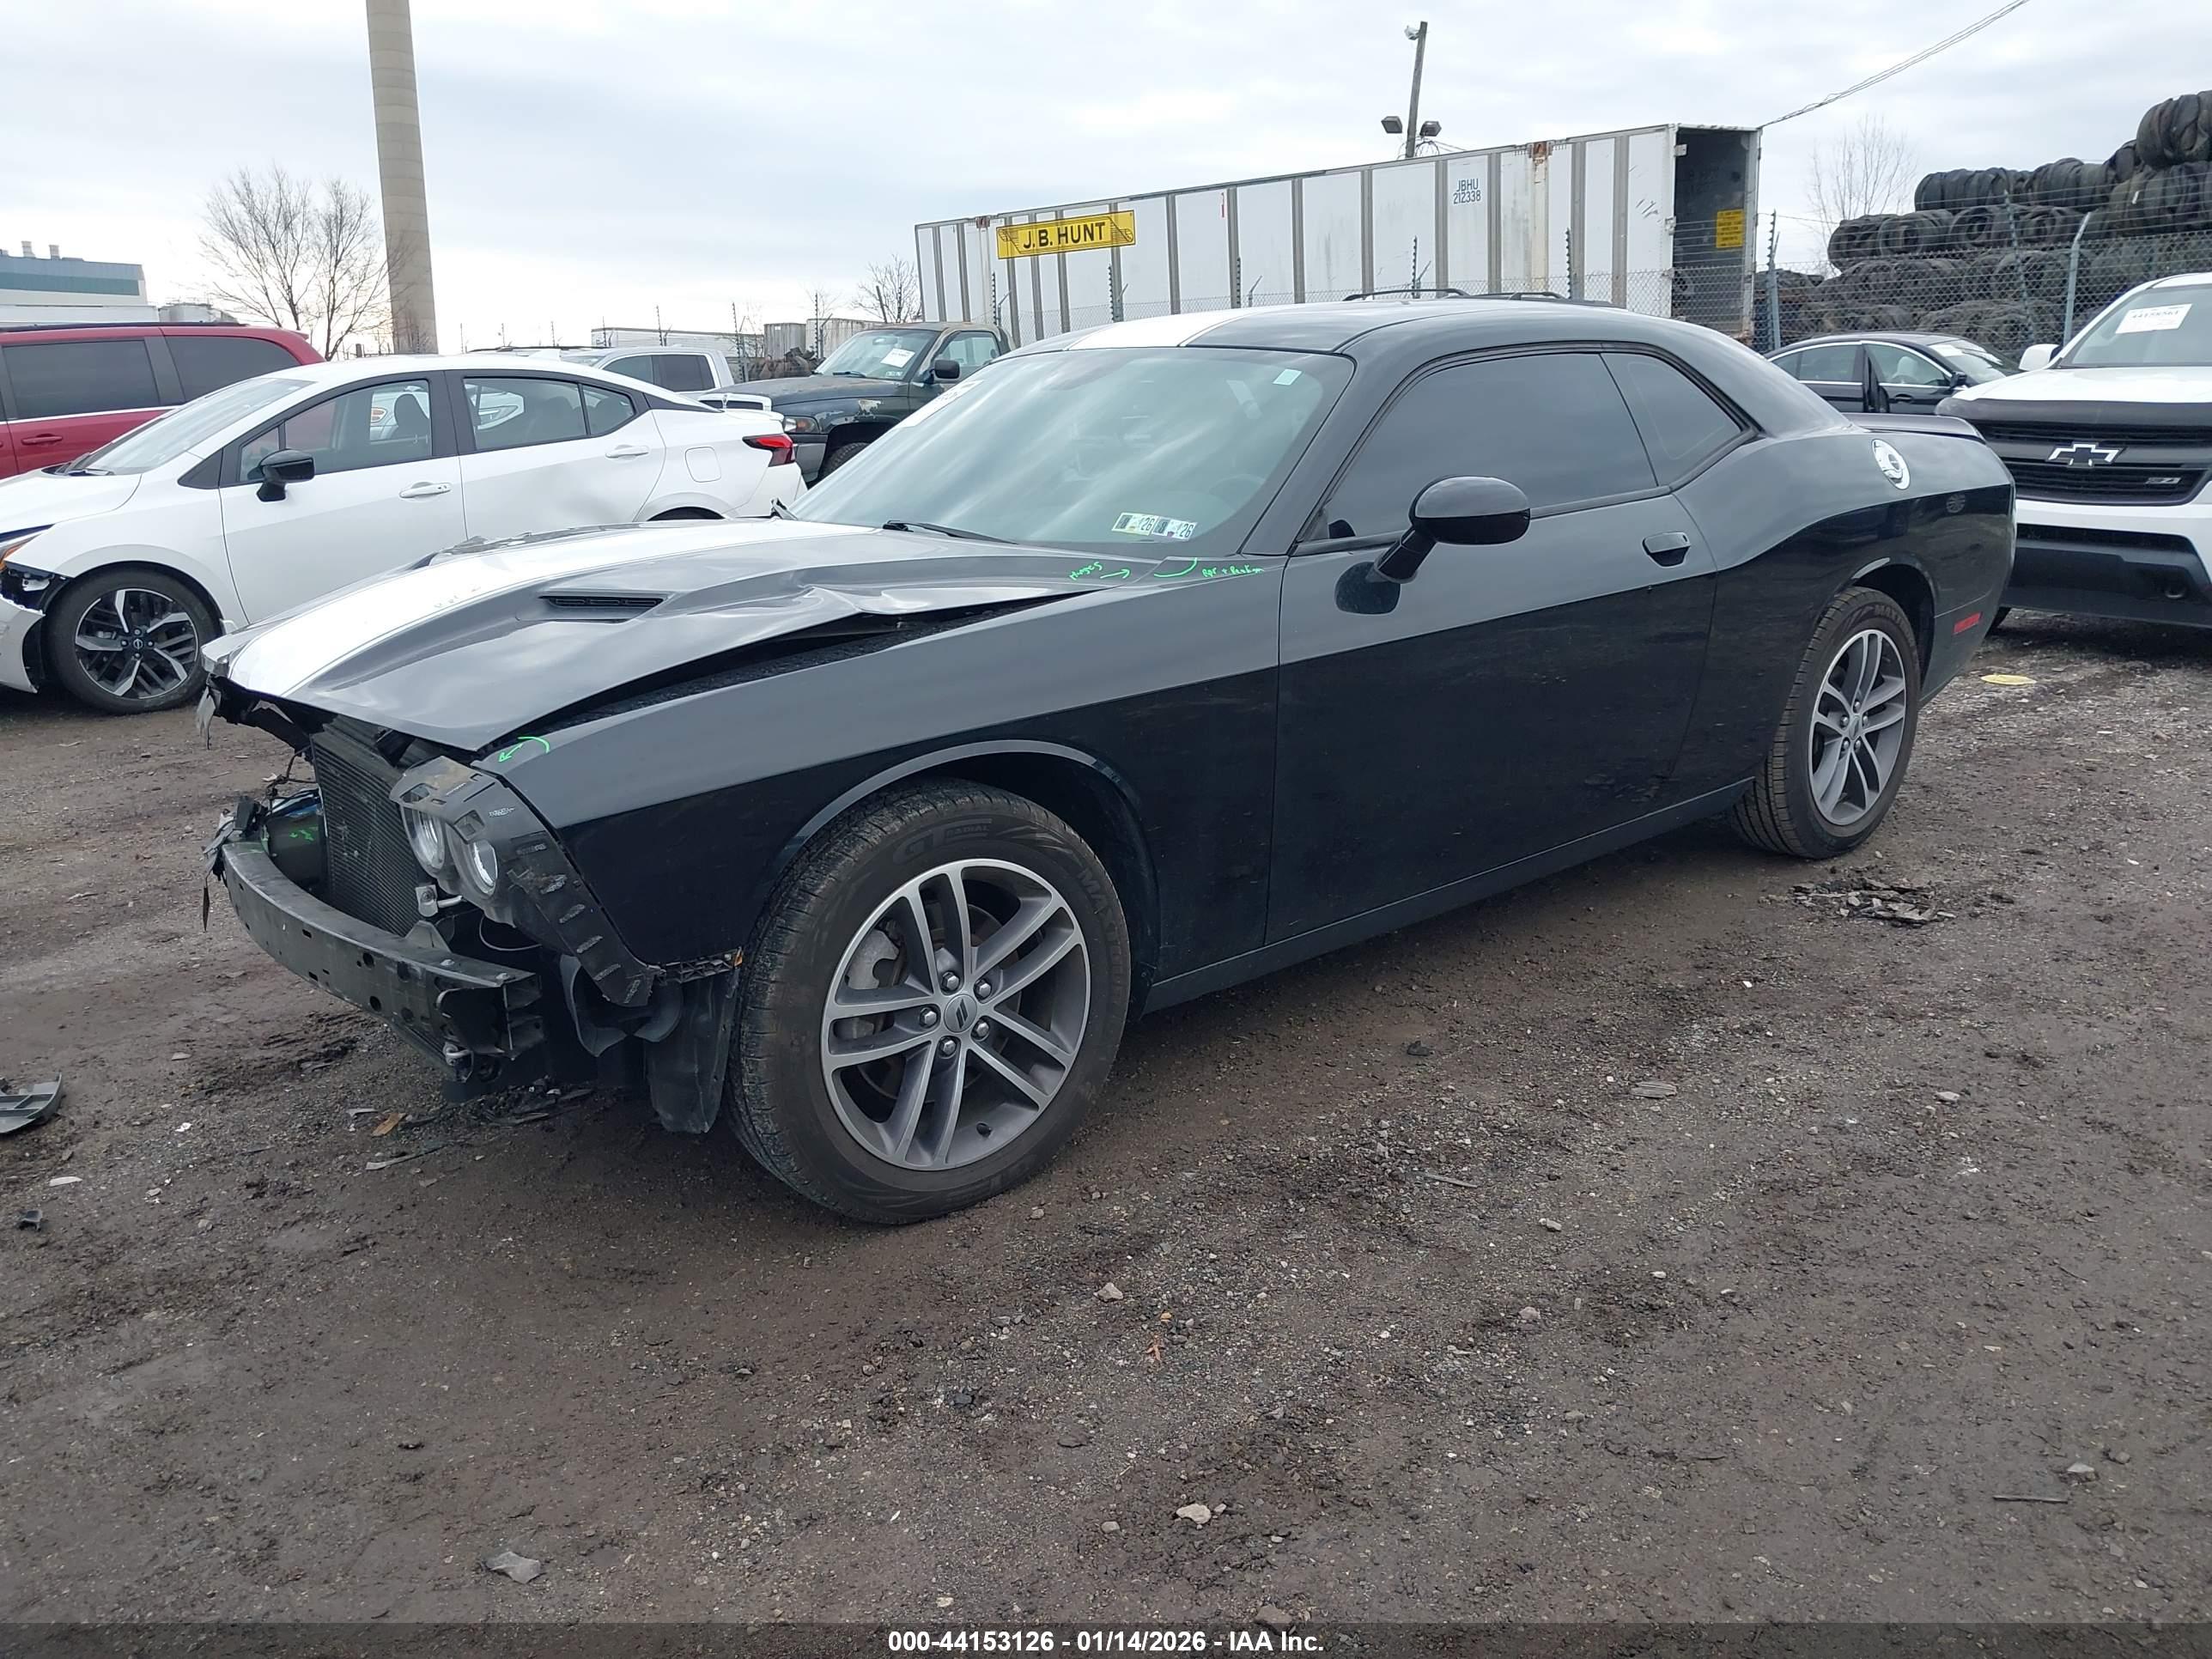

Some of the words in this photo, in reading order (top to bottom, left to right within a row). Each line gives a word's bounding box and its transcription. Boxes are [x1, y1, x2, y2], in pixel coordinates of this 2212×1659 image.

[1455, 178, 1479, 191] JBHU
[1452, 190, 1481, 204] 212338
[1057, 222, 1106, 246] HUNT
[1140, 517, 1156, 532] 26
[1179, 523, 1194, 538] 26
